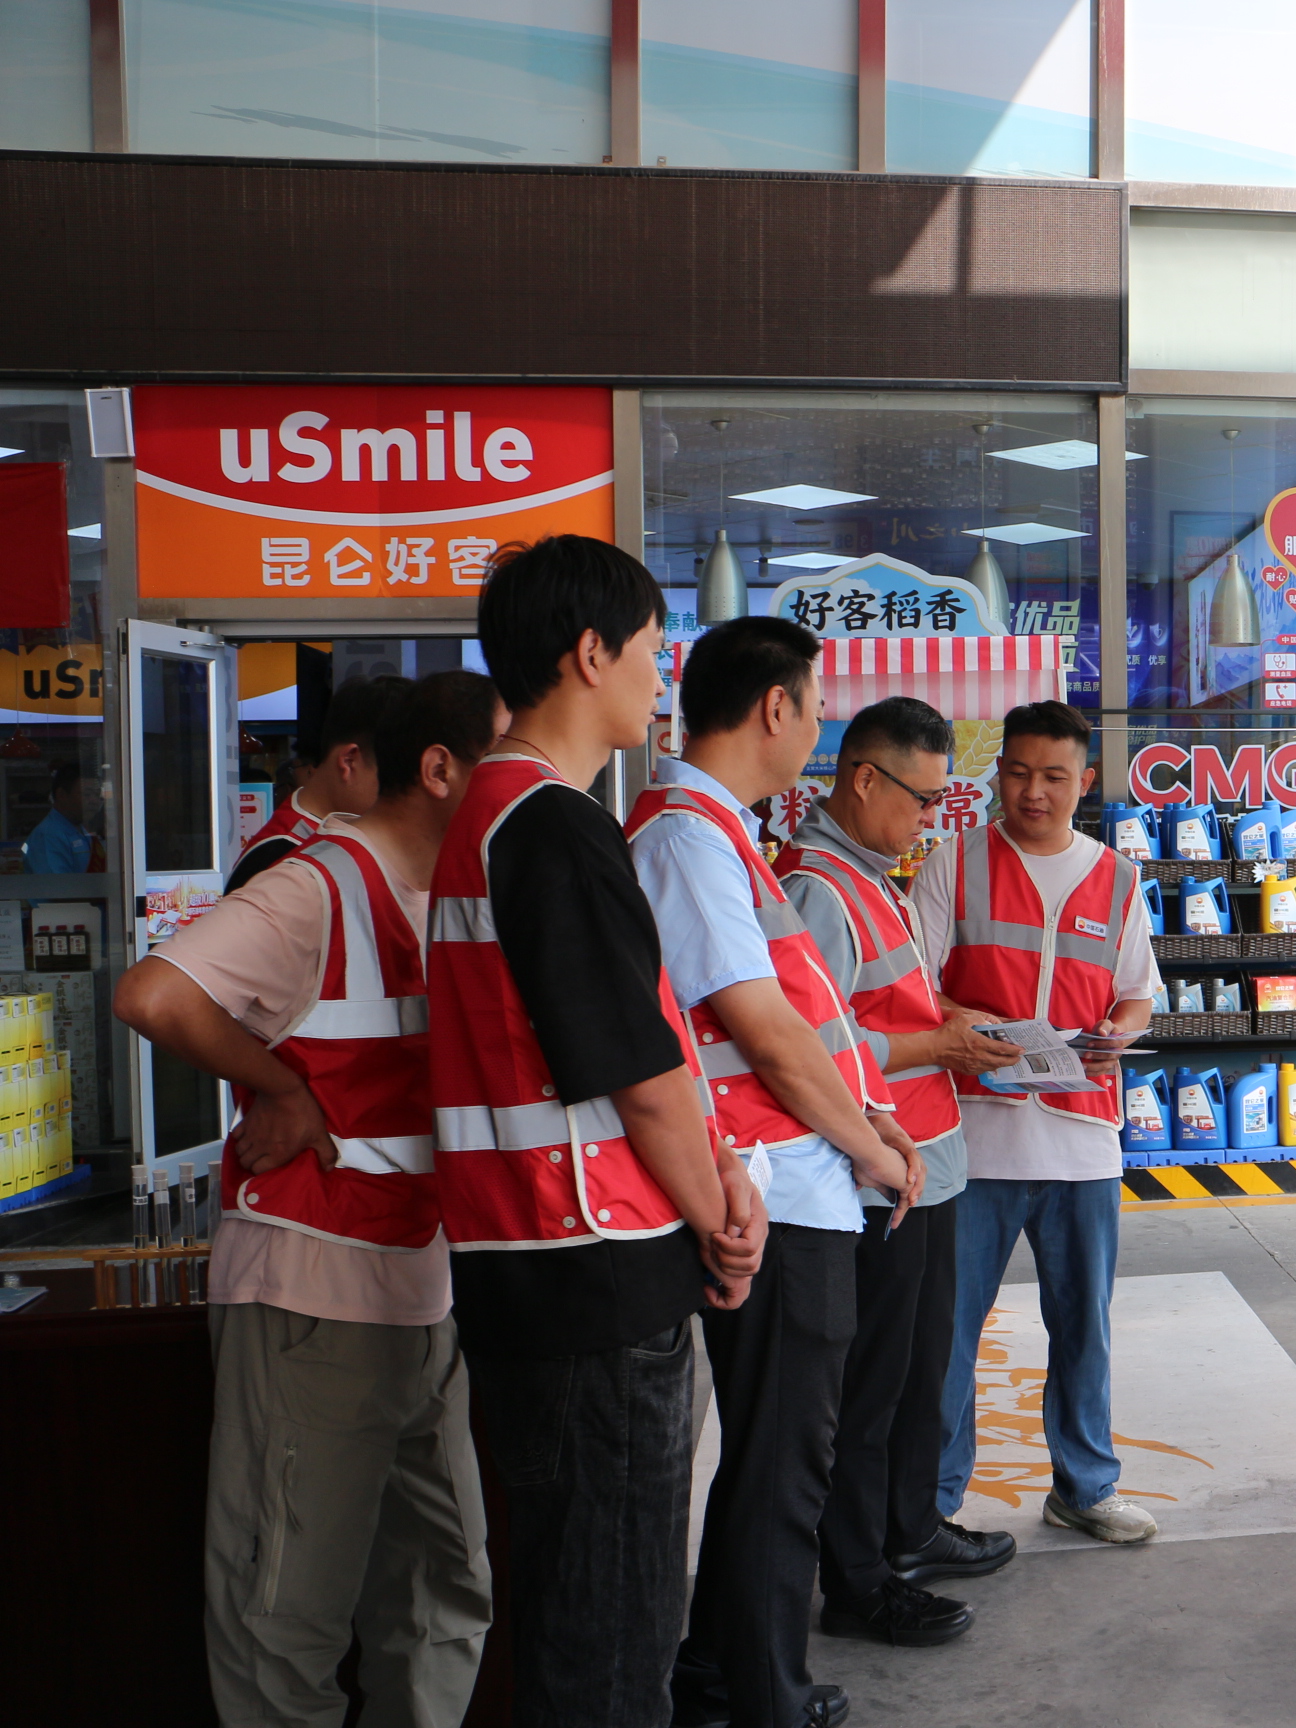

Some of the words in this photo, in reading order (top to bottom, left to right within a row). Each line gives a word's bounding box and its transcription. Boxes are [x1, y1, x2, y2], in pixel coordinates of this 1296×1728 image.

[219, 410, 533, 483] uSmile
[261, 536, 498, 586] 昆仑好客
[789, 588, 967, 633] 好客稻香
[1009, 597, 1081, 635] 优品
[1148, 655, 1167, 666] 优享
